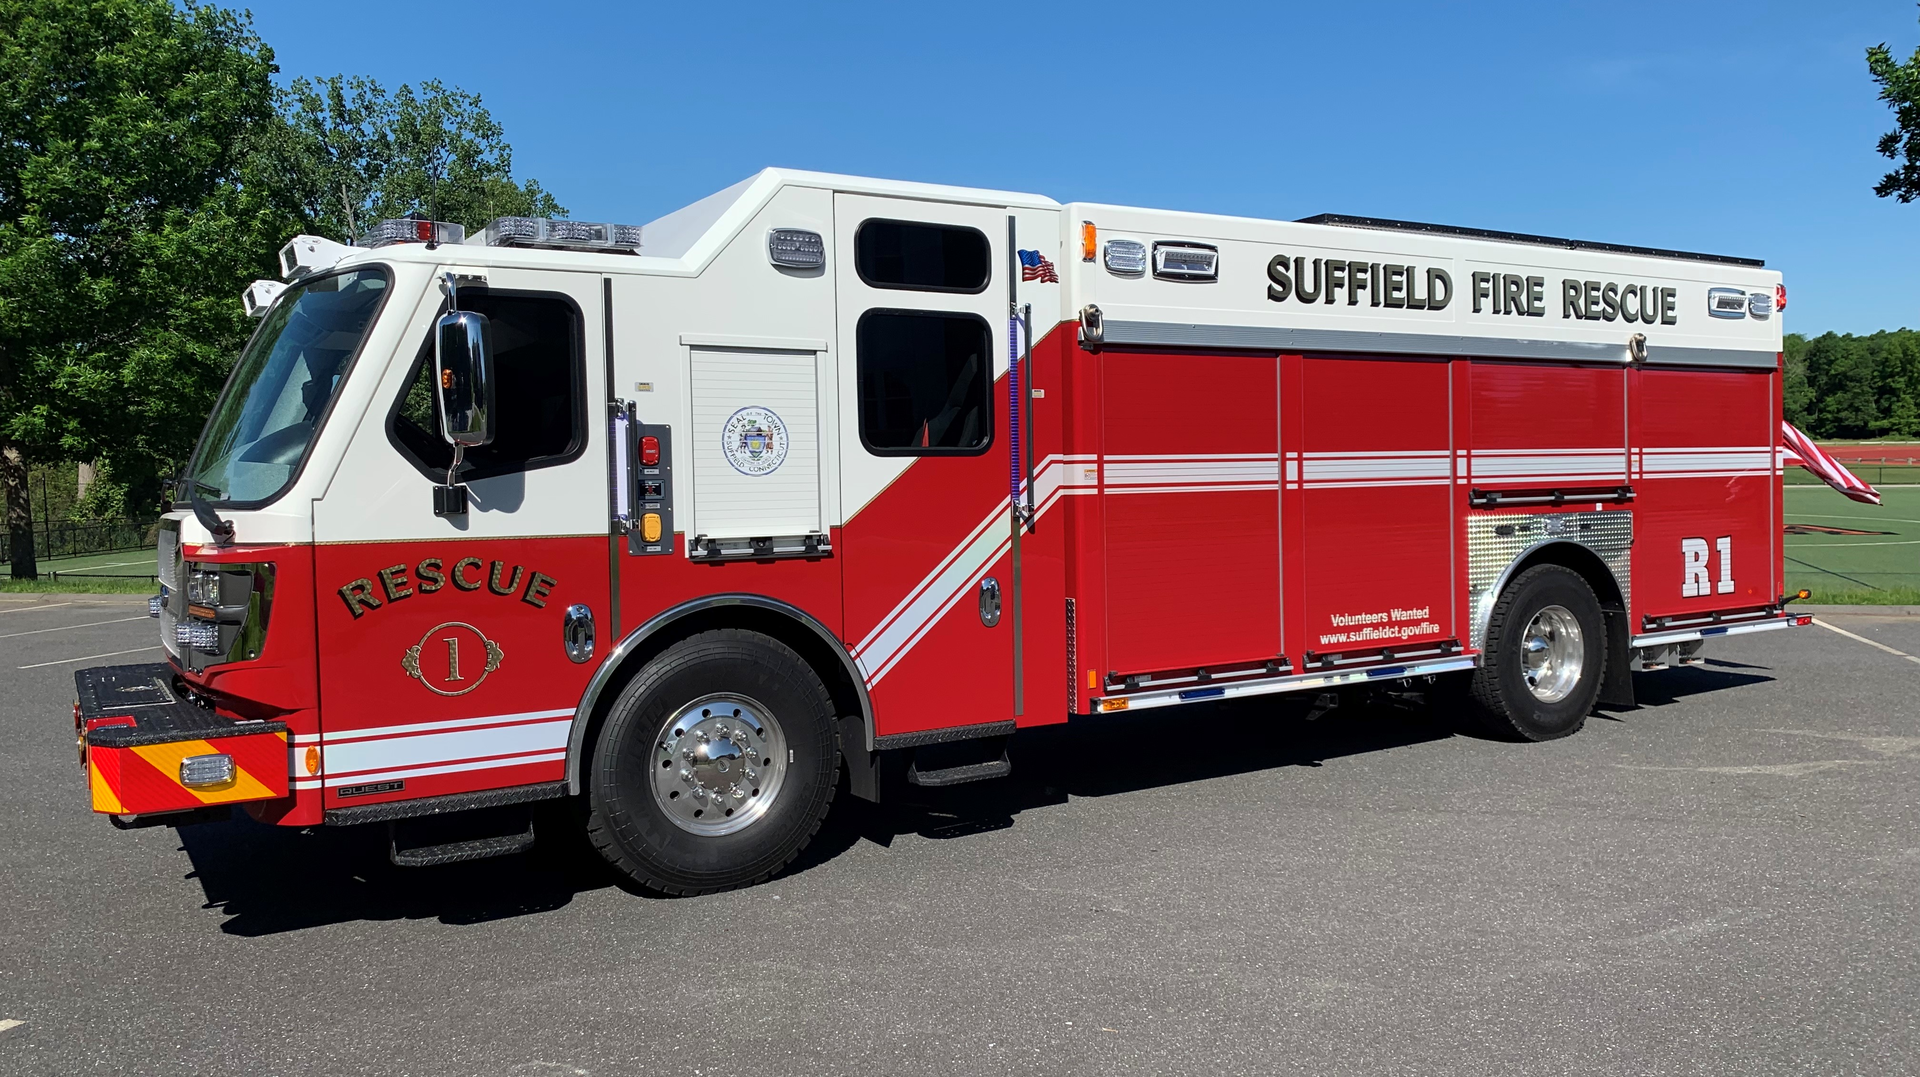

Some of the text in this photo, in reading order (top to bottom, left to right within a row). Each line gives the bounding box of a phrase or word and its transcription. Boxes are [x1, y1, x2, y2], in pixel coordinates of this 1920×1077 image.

[1267, 254, 1677, 325] SUFFIELD FIRE RESCUE
[728, 414, 746, 434] SEAL
[763, 412, 783, 436] TOWN
[726, 441, 785, 472] SUFFIELD CONNECTICUT
[1682, 534, 1735, 598] R1
[337, 557, 558, 620] RESCUE
[1331, 606, 1429, 627] Volunteers Wanted
[1320, 622, 1440, 645] www.suffieldct.gov/fire
[443, 637, 464, 681] 1
[340, 782, 402, 794] QUEST
